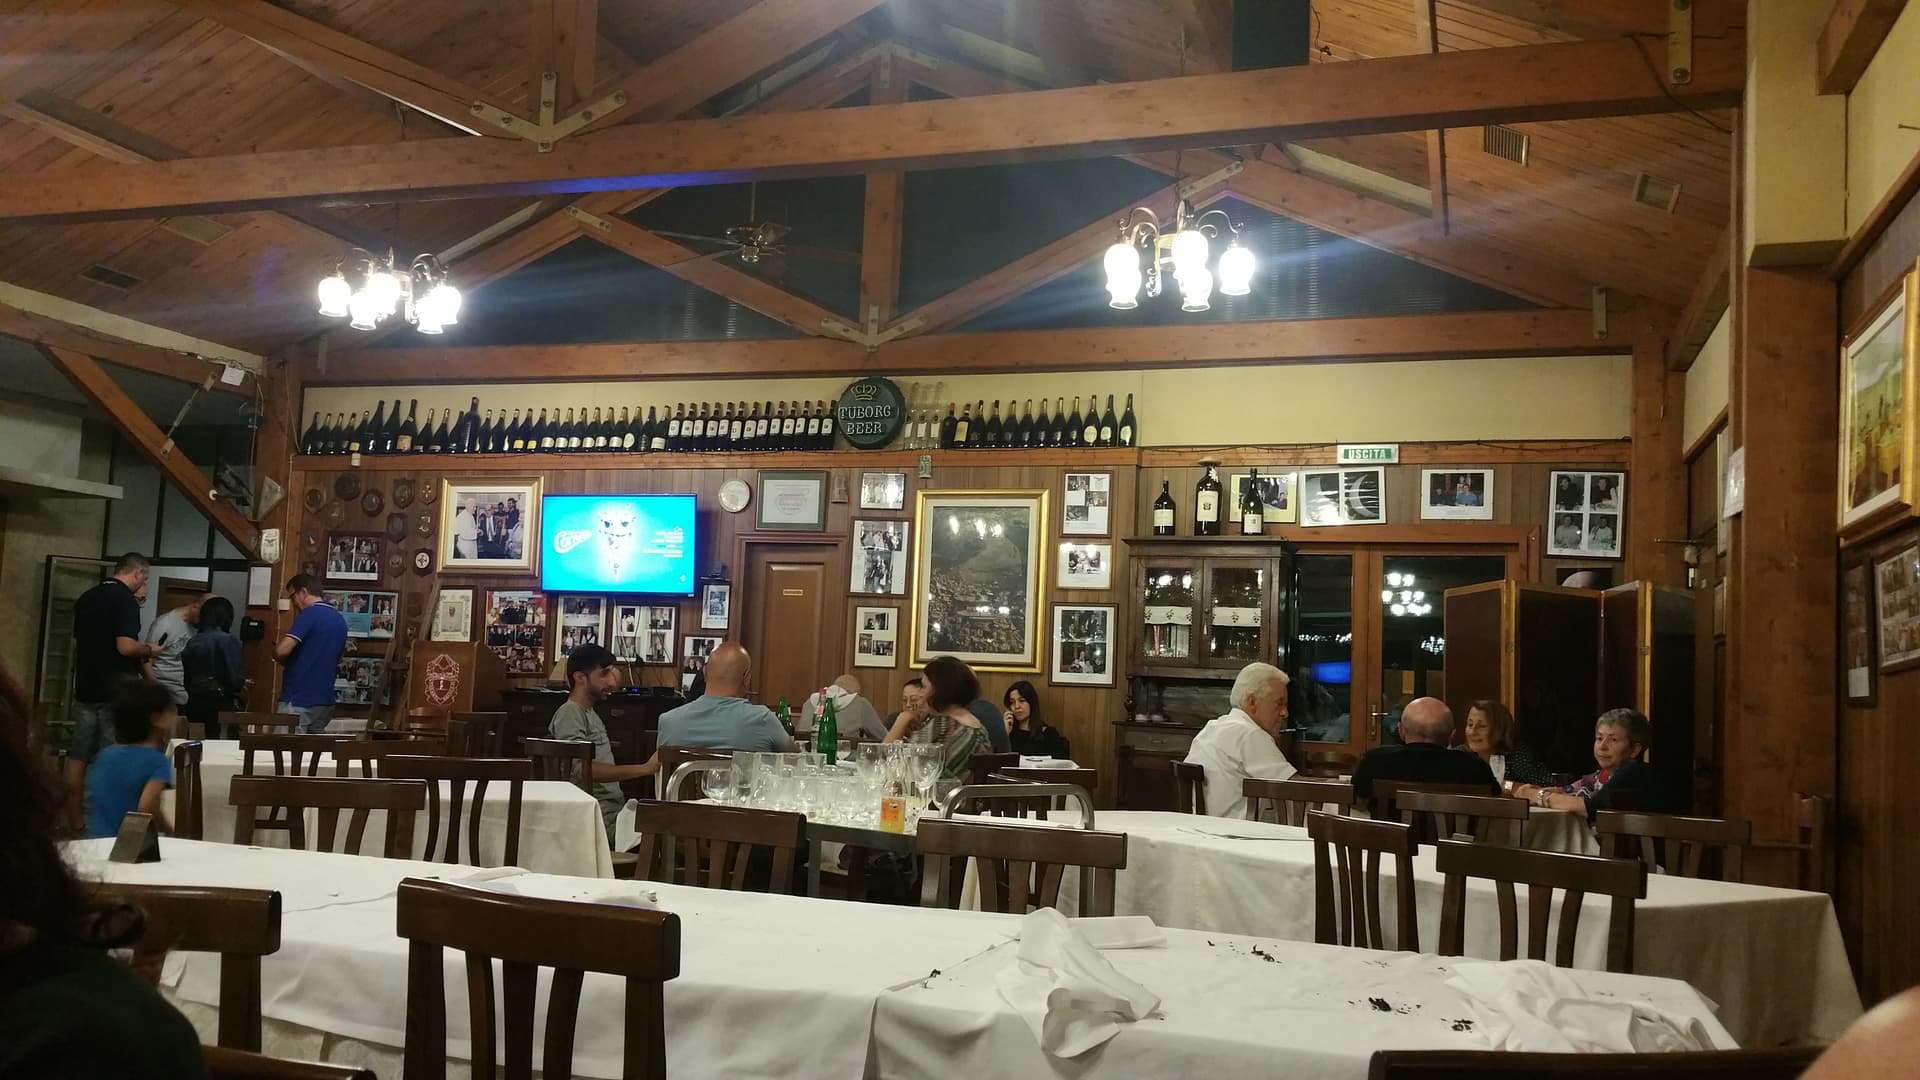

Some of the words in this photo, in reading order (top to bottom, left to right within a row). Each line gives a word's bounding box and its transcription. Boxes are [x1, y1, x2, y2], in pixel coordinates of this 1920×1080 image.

[839, 405, 891, 419] TUBORG
[847, 421, 882, 435] BEER
[1348, 448, 1386, 460] USCITA
